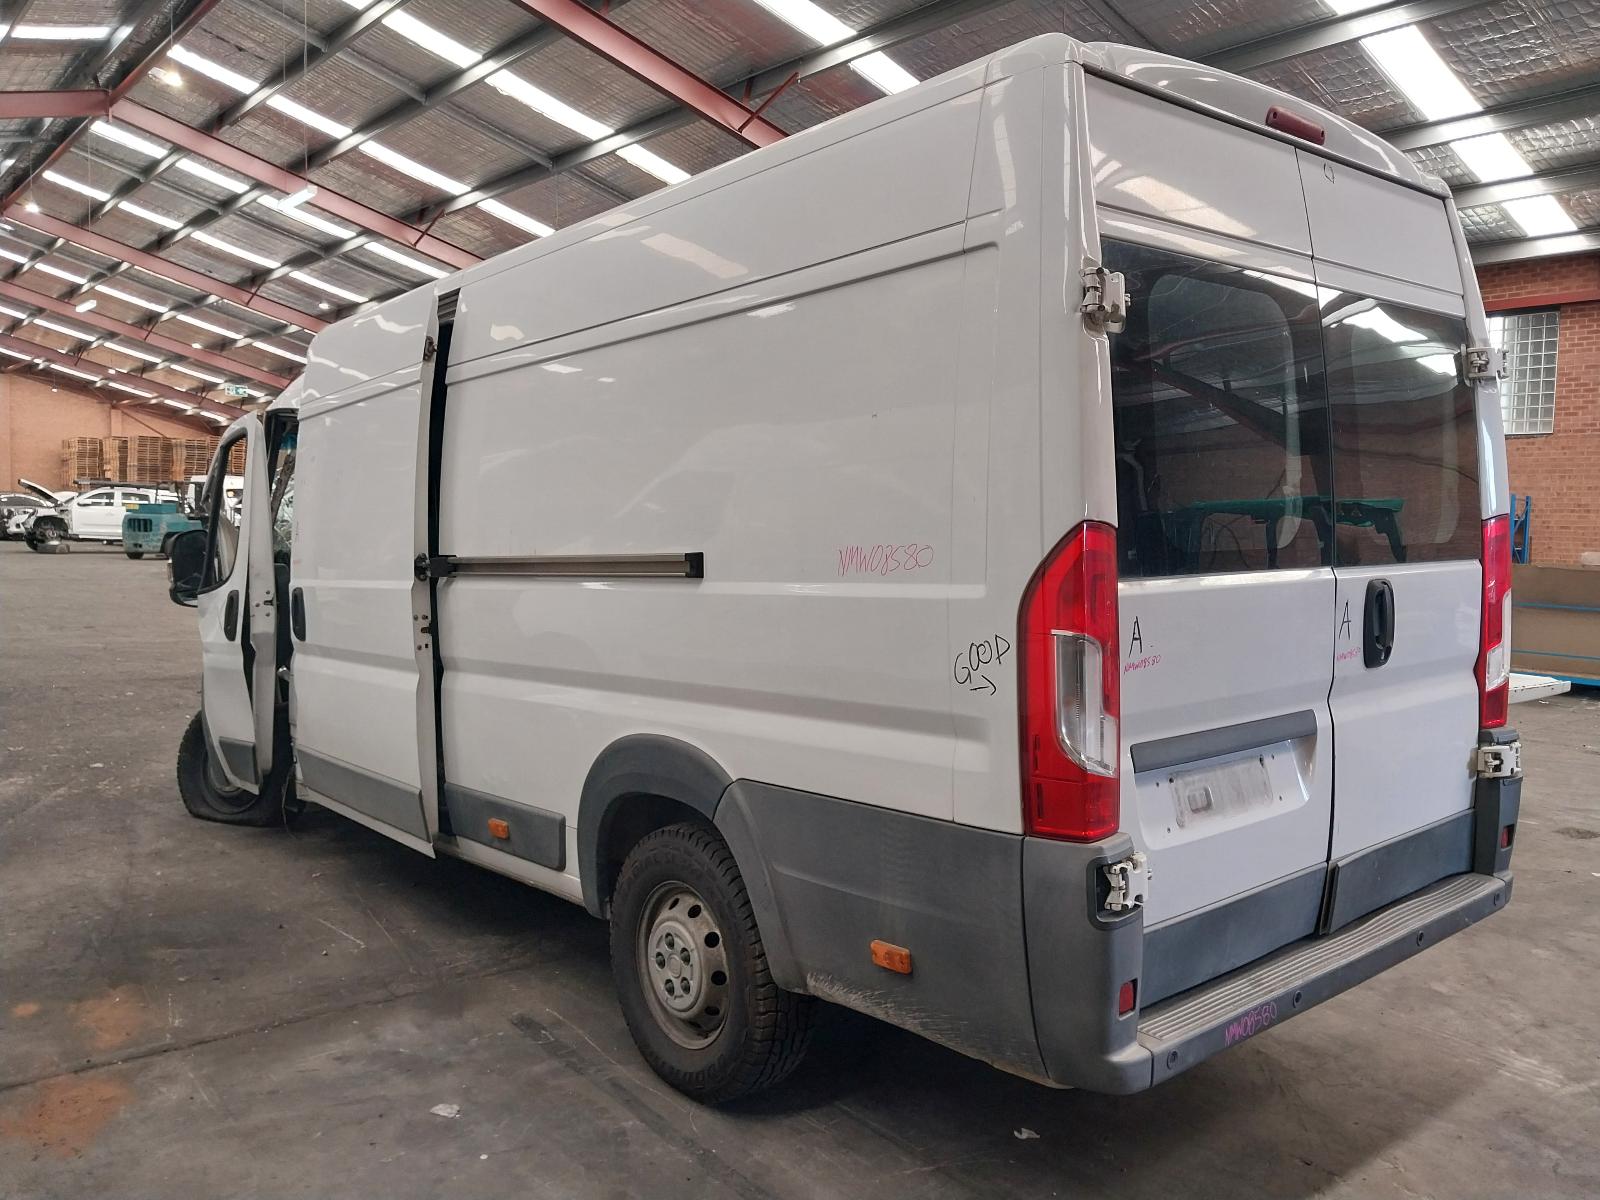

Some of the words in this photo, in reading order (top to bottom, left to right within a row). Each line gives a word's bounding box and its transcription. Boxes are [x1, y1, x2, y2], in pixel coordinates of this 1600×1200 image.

[838, 543, 934, 577] NMW08580
[1128, 615, 1143, 658] A
[1337, 600, 1352, 640] A
[954, 634, 1011, 684] GOOD
